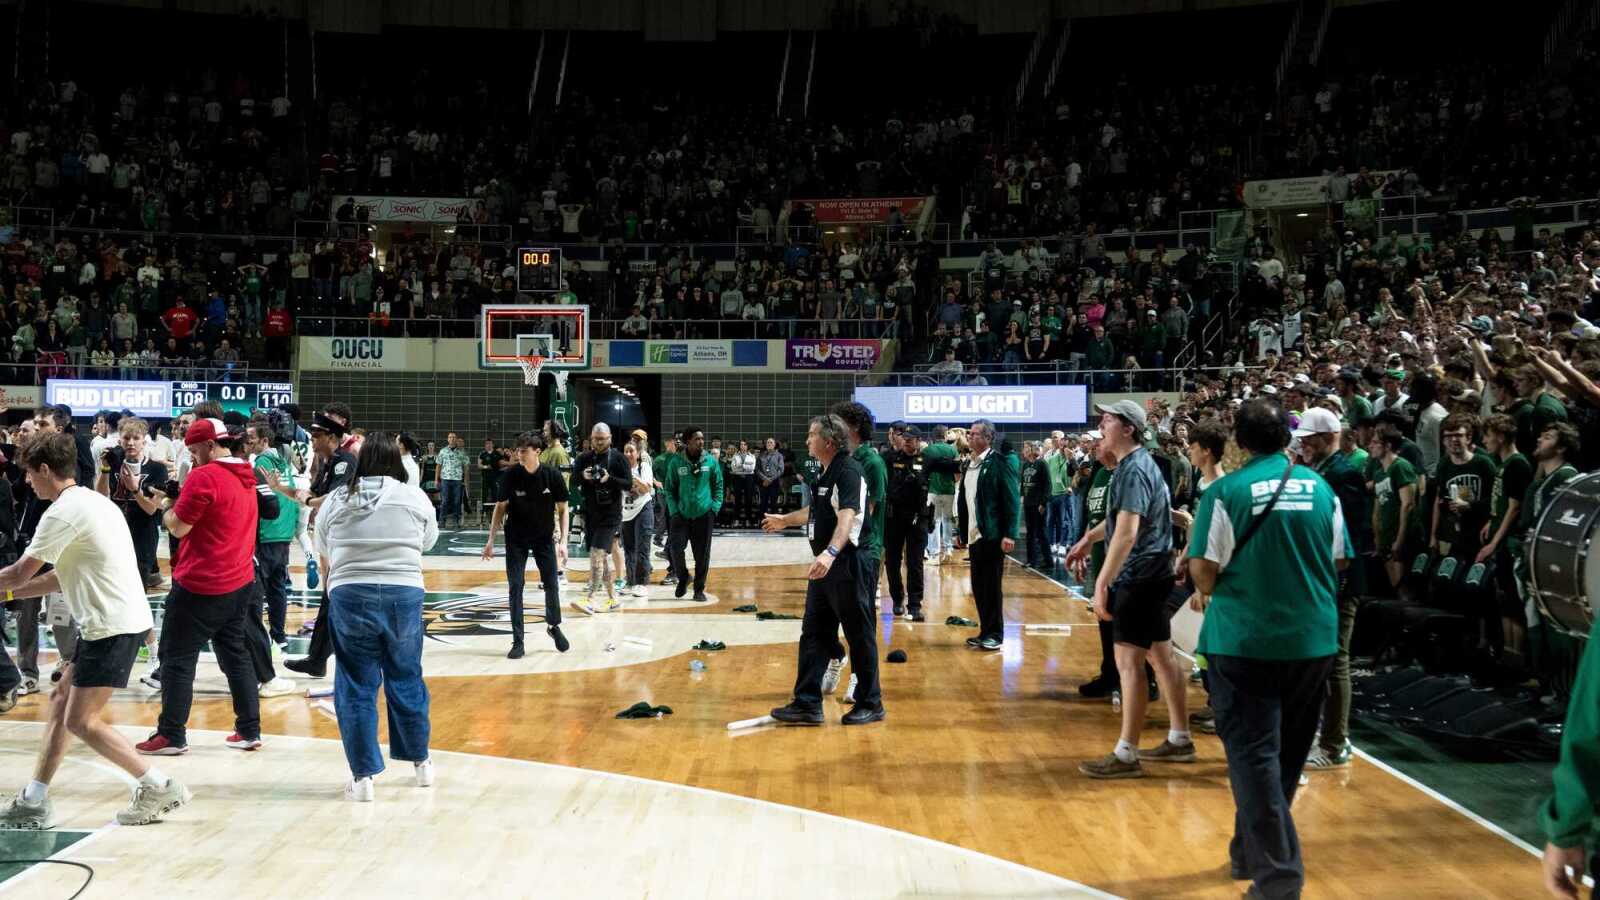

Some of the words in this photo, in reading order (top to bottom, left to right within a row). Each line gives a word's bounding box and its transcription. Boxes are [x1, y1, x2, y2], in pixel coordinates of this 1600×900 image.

[392, 205, 423, 214] SONIC
[331, 338, 383, 359] OUCU
[792, 342, 875, 362] TRUSTED
[55, 387, 101, 406] BUD
[102, 388, 163, 408] LIGHT
[222, 386, 245, 400] 0.0
[907, 395, 957, 413] BUD
[959, 394, 1028, 413] LIGHT
